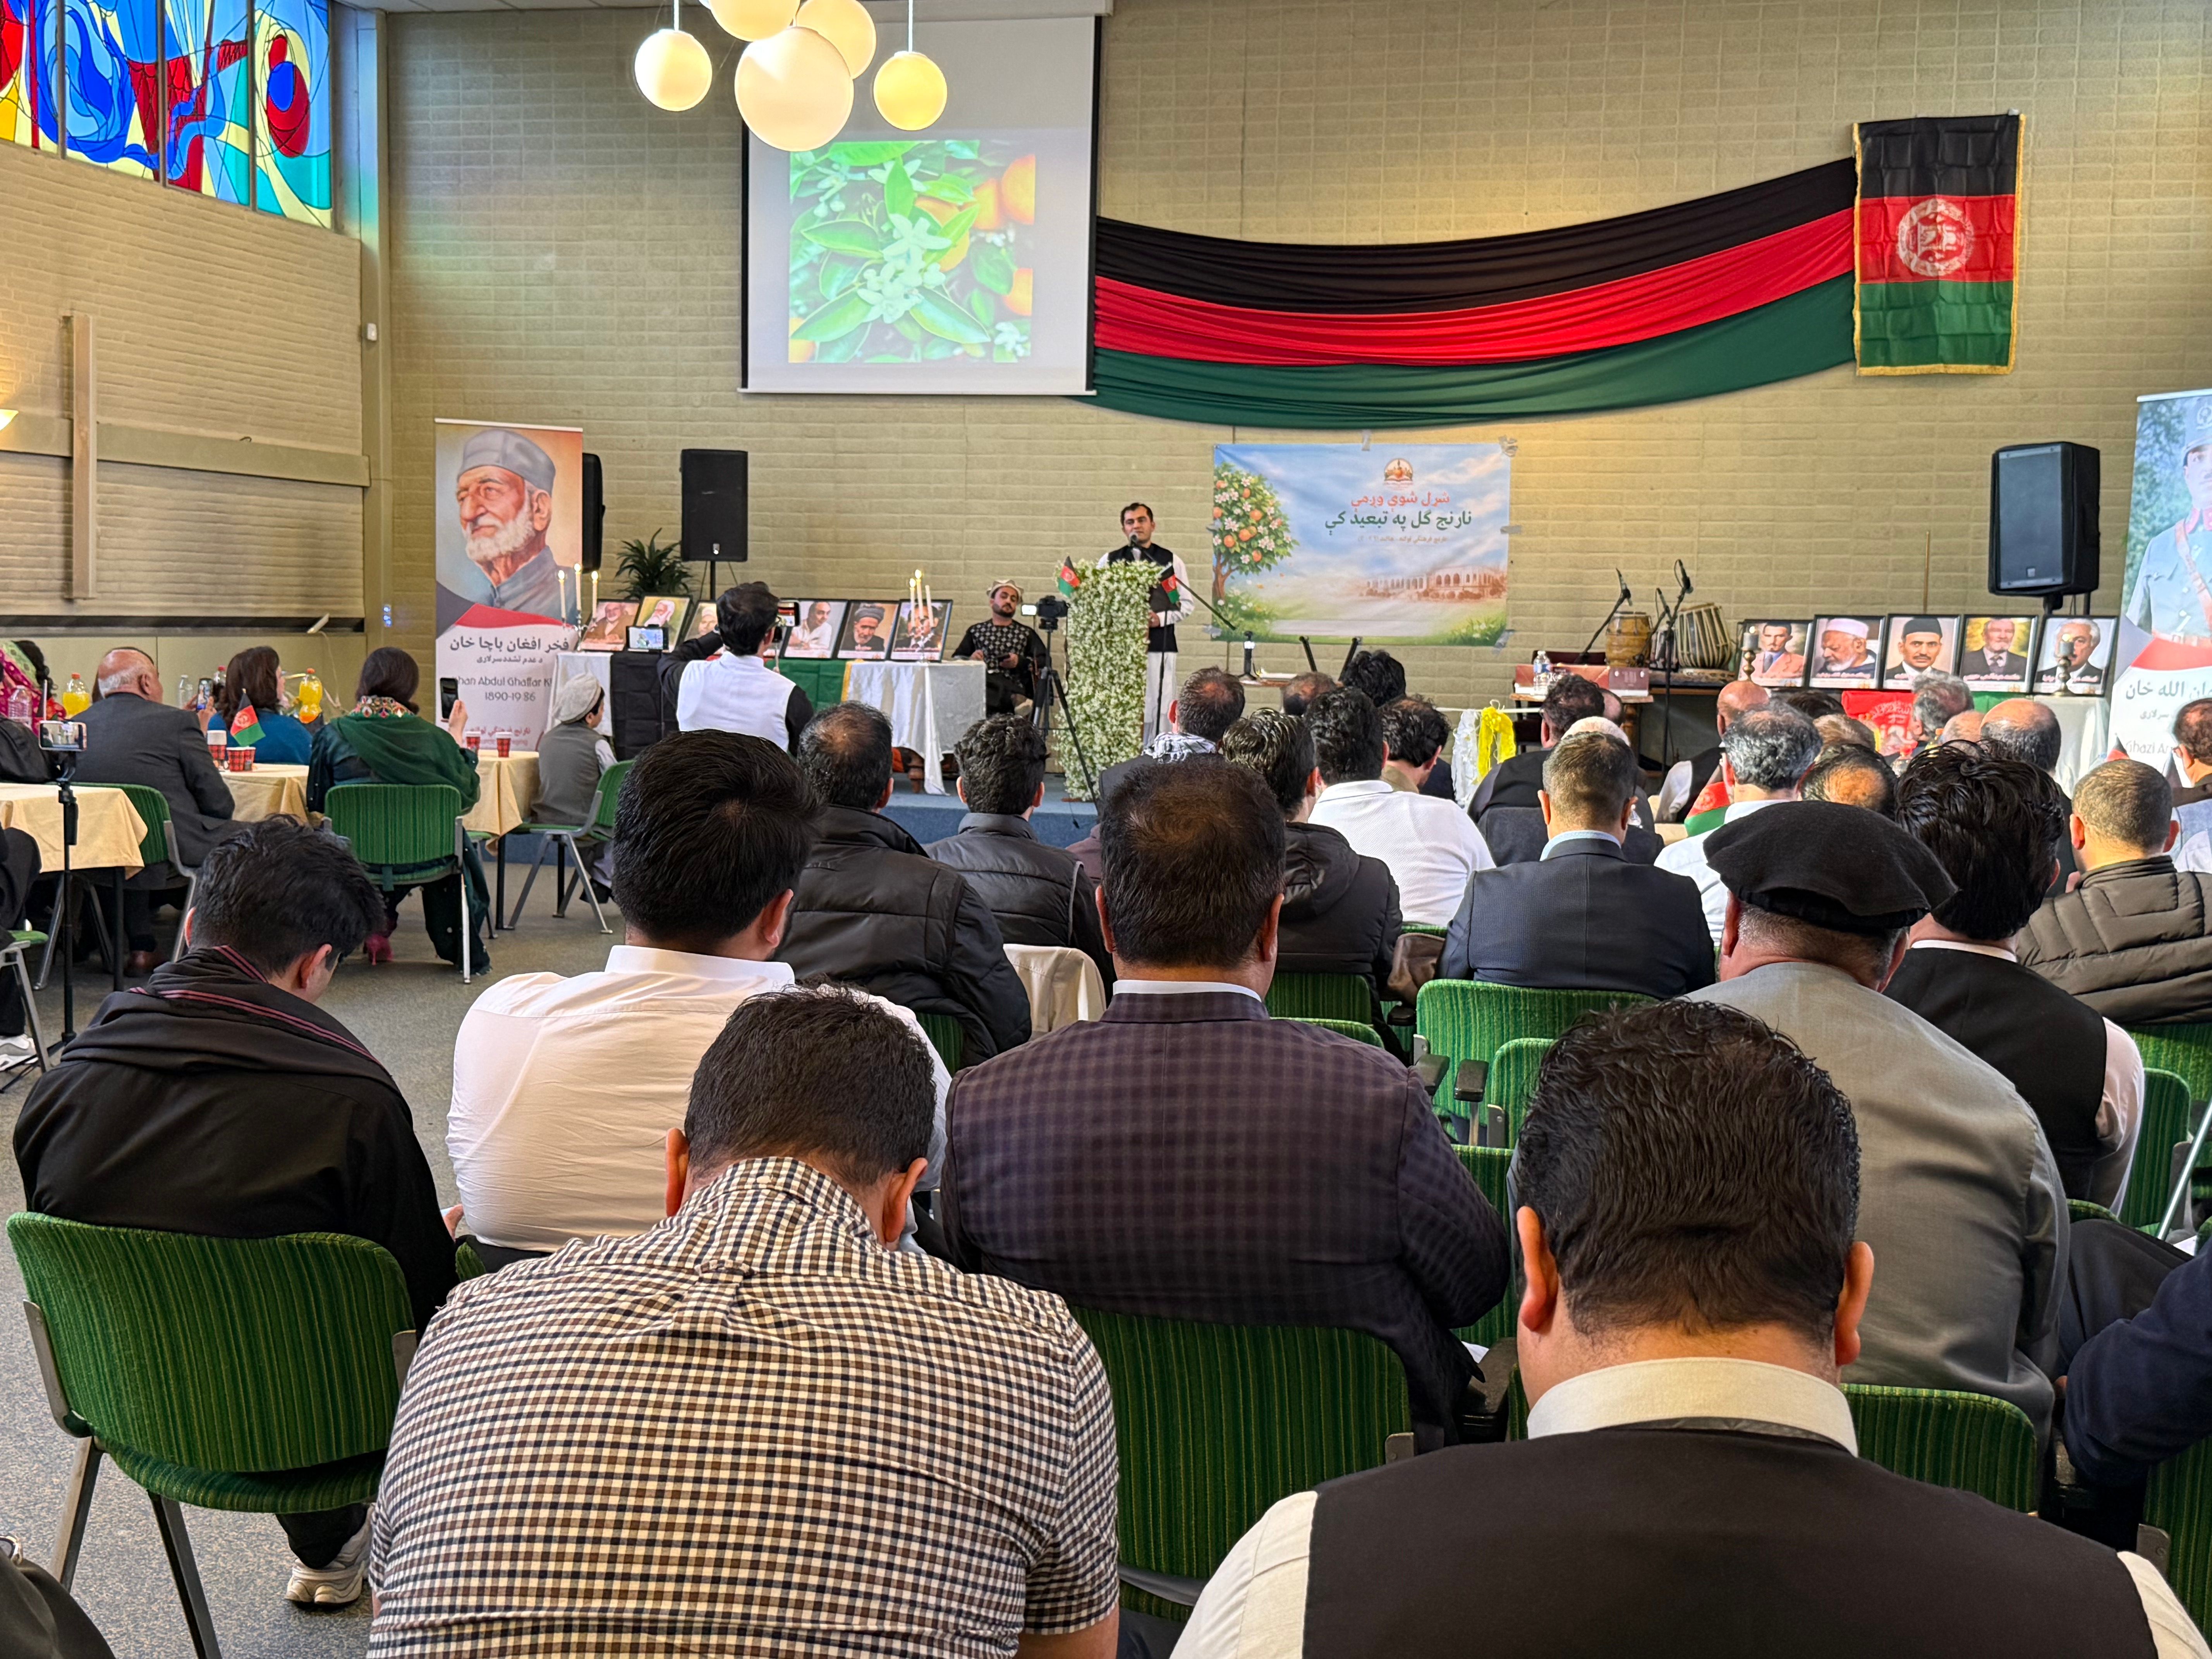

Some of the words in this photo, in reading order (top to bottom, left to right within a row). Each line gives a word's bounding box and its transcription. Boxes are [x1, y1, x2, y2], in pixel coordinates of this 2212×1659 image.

[1393, 514, 1406, 532] په
[1436, 511, 1472, 531] نارنج
[450, 636, 475, 651] خان
[479, 637, 503, 652] باچا
[507, 637, 541, 652] افغان
[545, 637, 569, 653] فخر
[456, 677, 476, 685] han
[478, 677, 505, 686] Abdul
[507, 677, 542, 687] Ghaffar
[2126, 679, 2154, 700] خان
[2158, 680, 2185, 697] الله
[2126, 740, 2155, 754] Ghazi
